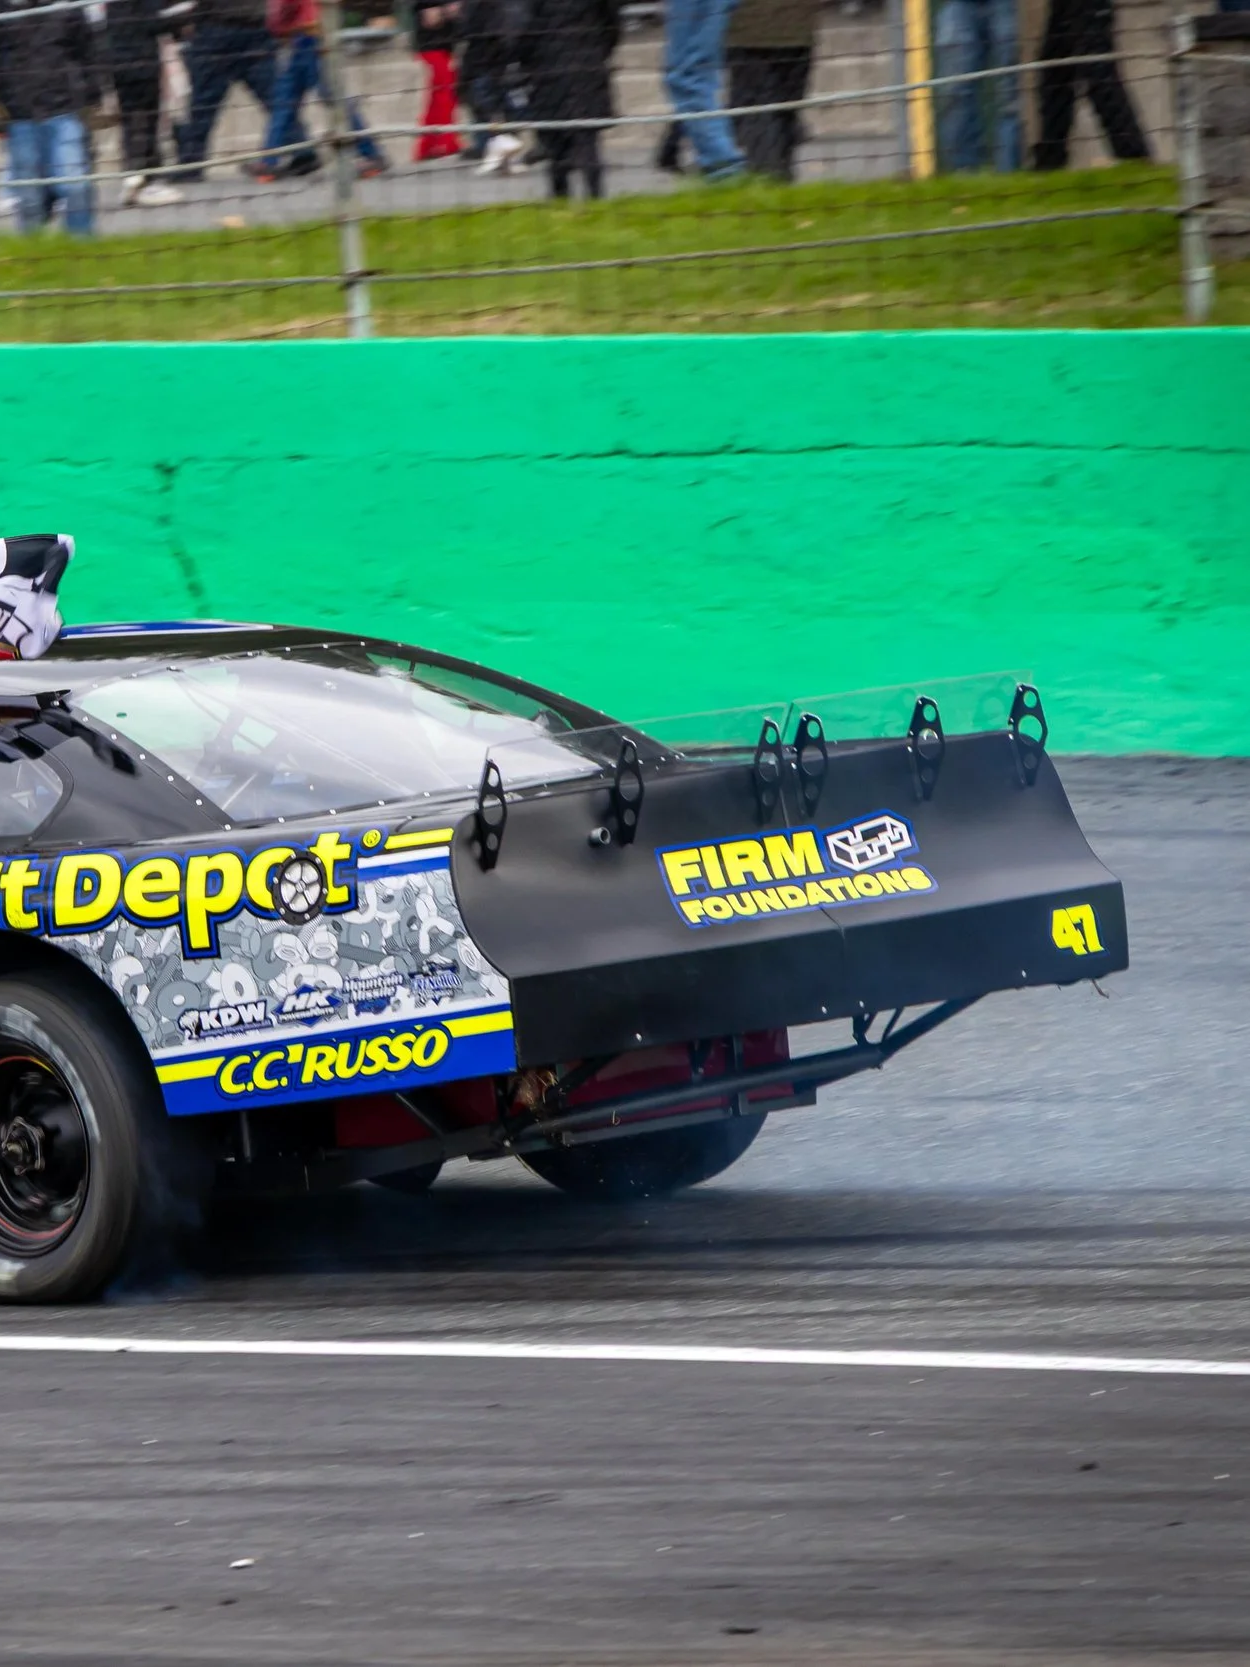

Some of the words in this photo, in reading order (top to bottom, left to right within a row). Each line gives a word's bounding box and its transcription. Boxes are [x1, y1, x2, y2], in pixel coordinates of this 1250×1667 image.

[661, 830, 827, 896] FIRM
[679, 866, 933, 925] FOUNDATIONS
[1051, 903, 1105, 956] 47
[200, 1002, 266, 1031] KDW
[219, 1050, 289, 1095] C.C.
[301, 1028, 449, 1084] RUSSO
